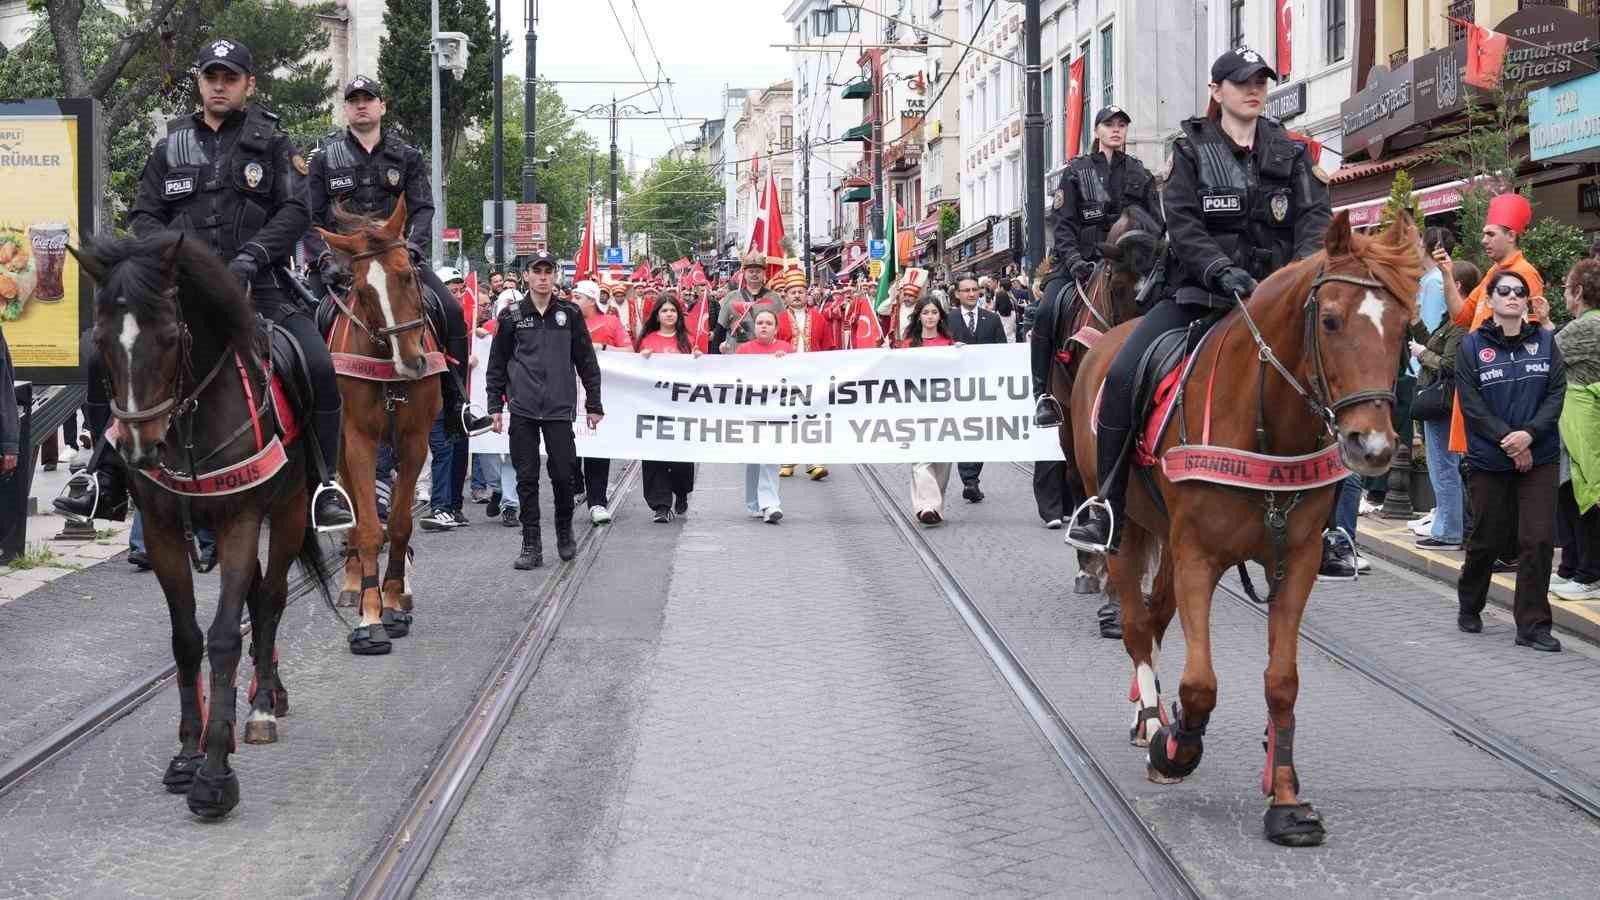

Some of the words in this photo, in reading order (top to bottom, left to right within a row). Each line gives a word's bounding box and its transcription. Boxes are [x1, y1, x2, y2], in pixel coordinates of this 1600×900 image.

[654, 378, 813, 406] “FATİH’İN
[828, 375, 1030, 405] İSTANBUL’U
[635, 412, 832, 445] FETHETTİĞİ
[848, 416, 1030, 450] YAŞTASIN!
[1267, 462, 1321, 484] ATLI
